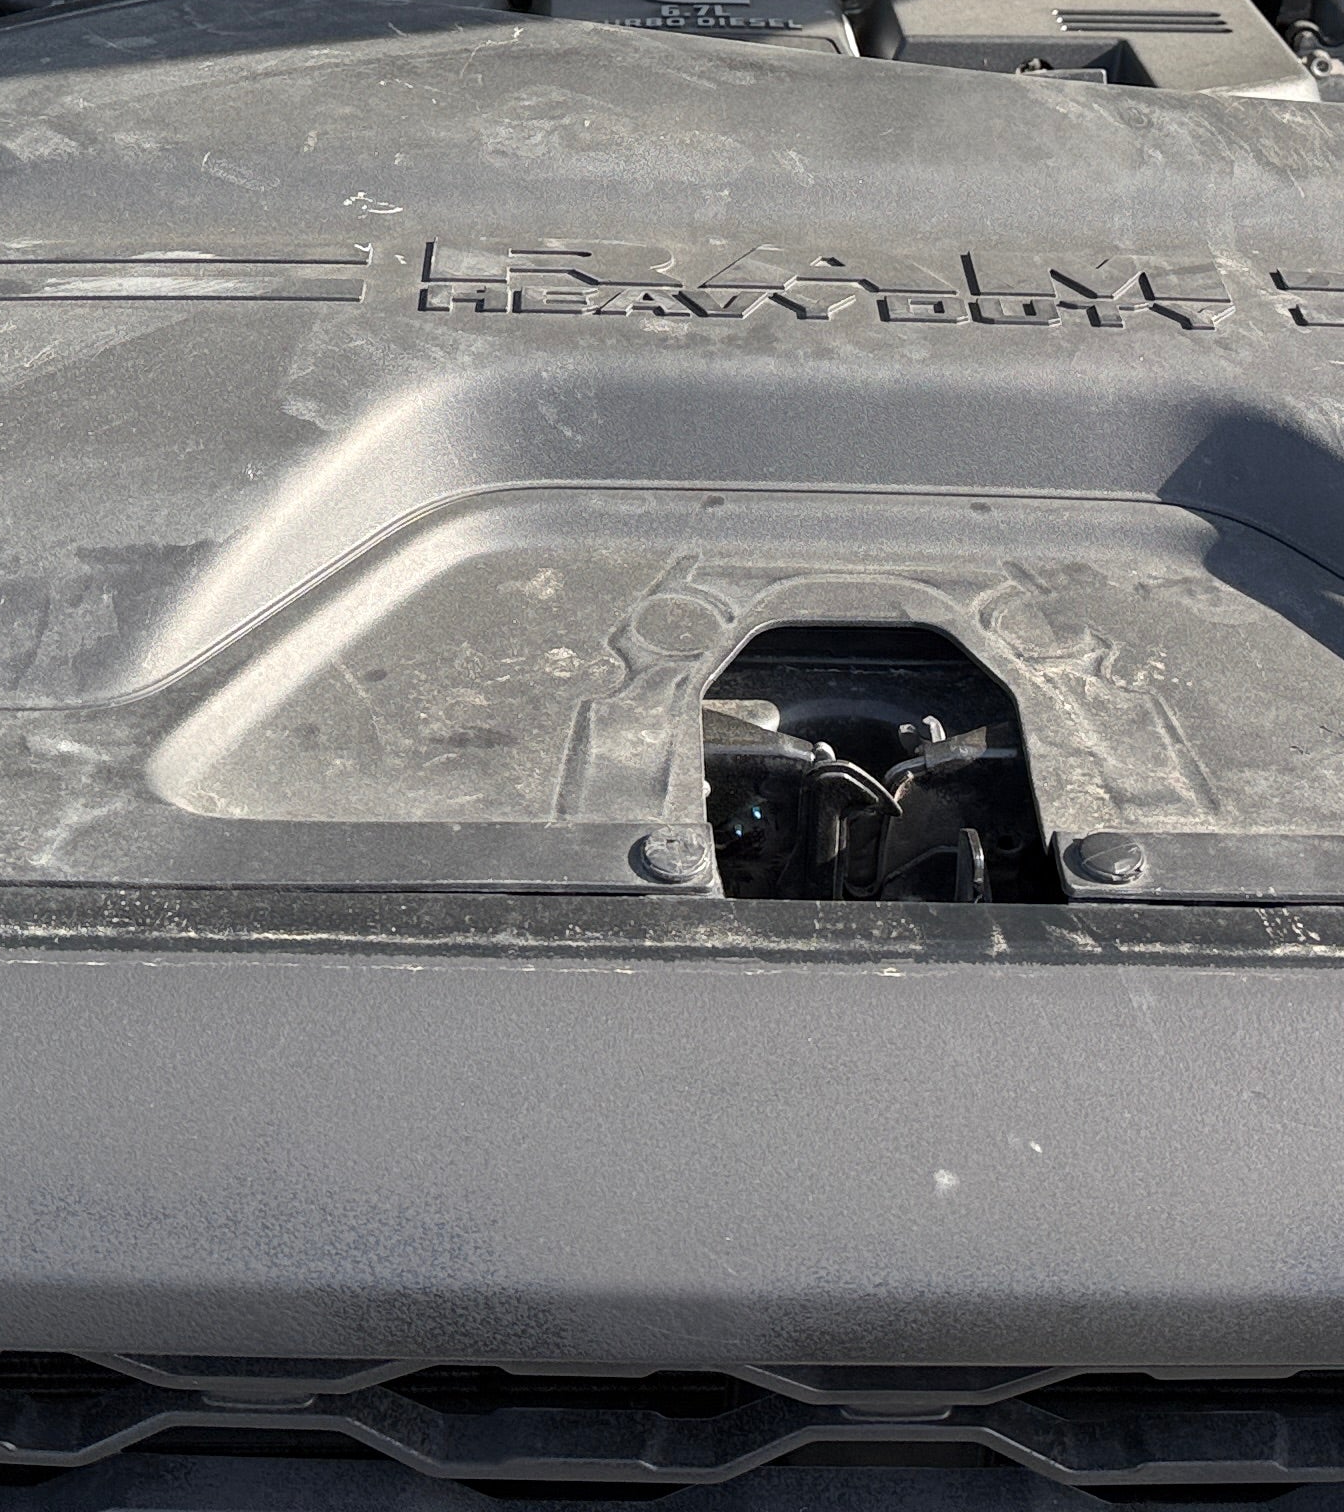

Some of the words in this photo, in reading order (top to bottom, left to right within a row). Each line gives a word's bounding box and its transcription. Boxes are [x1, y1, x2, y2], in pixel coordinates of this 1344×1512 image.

[660, 4, 731, 17] 6.7L
[603, 17, 687, 28] URBO
[696, 17, 804, 30] DIESEL
[417, 284, 857, 321] HEAVY
[875, 292, 1238, 331] DUTY
